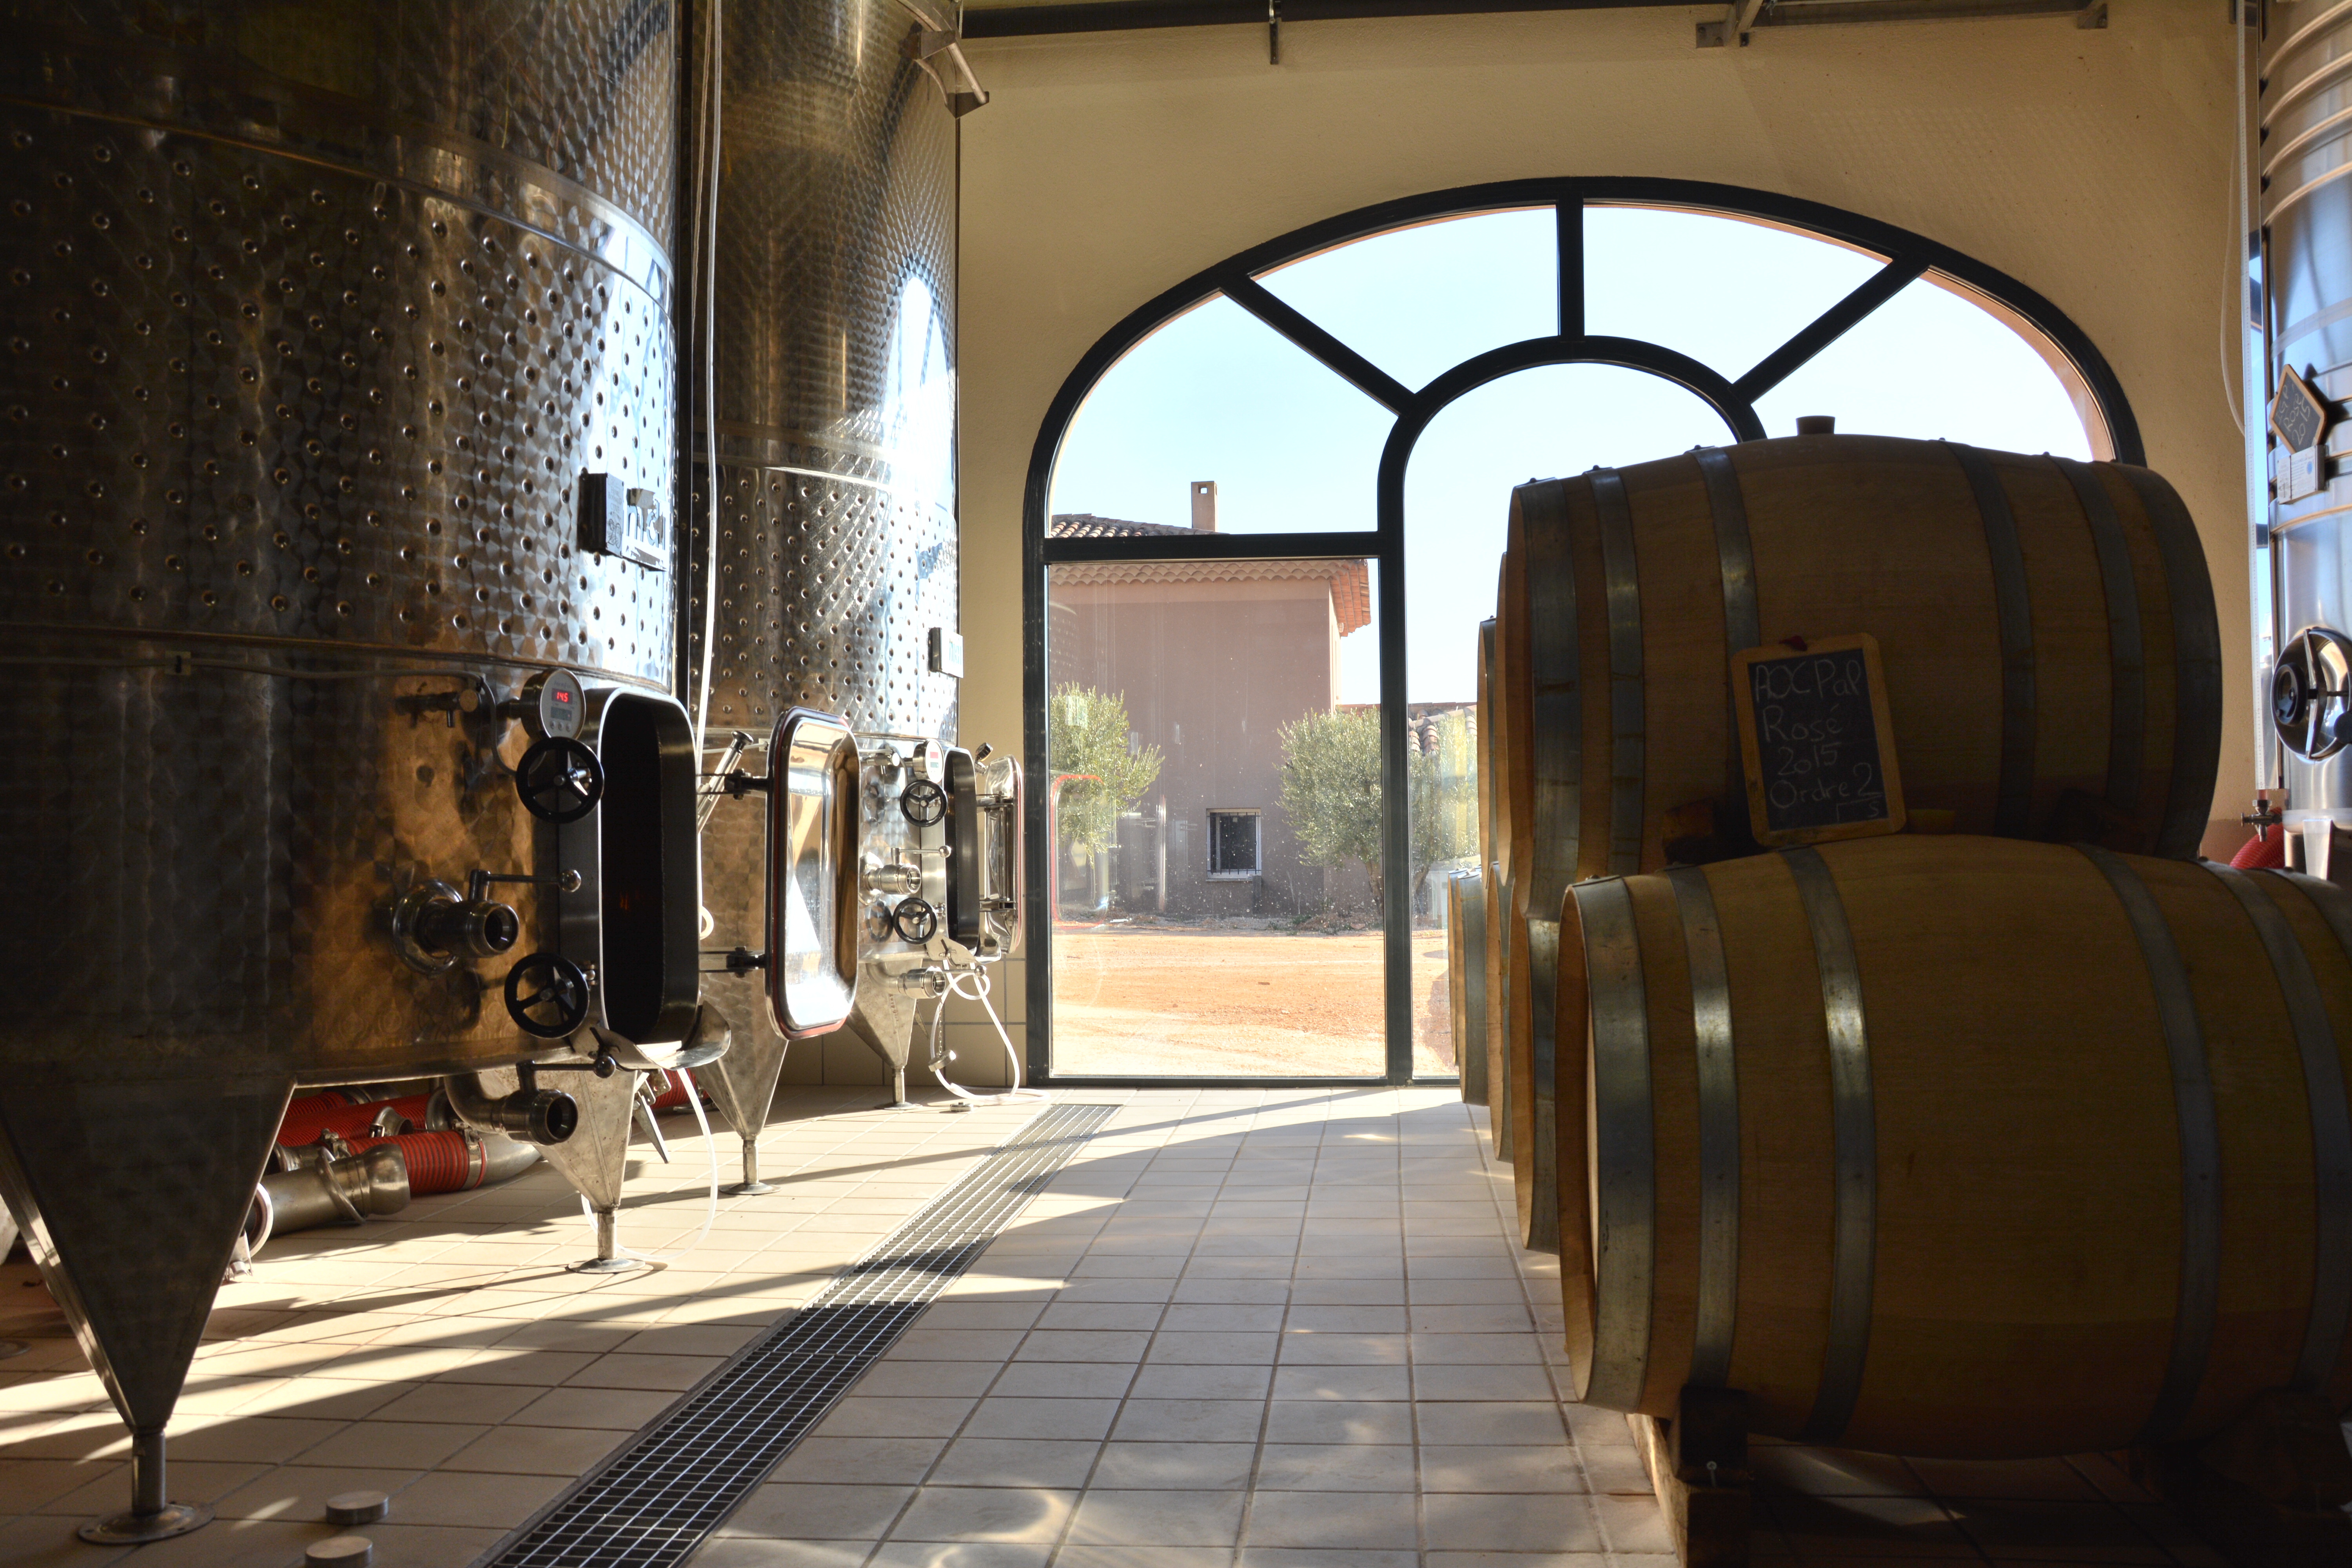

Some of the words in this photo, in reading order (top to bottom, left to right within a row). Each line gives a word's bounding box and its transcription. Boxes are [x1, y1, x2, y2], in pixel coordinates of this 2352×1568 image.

[2292, 396, 2310, 446] 2015
[1755, 661, 1811, 703] AOC
[1763, 703, 1843, 742] Rosé
[1777, 741, 1842, 775] 2015
[1769, 778, 1850, 809] Ordre
[1853, 762, 1882, 796] 2
